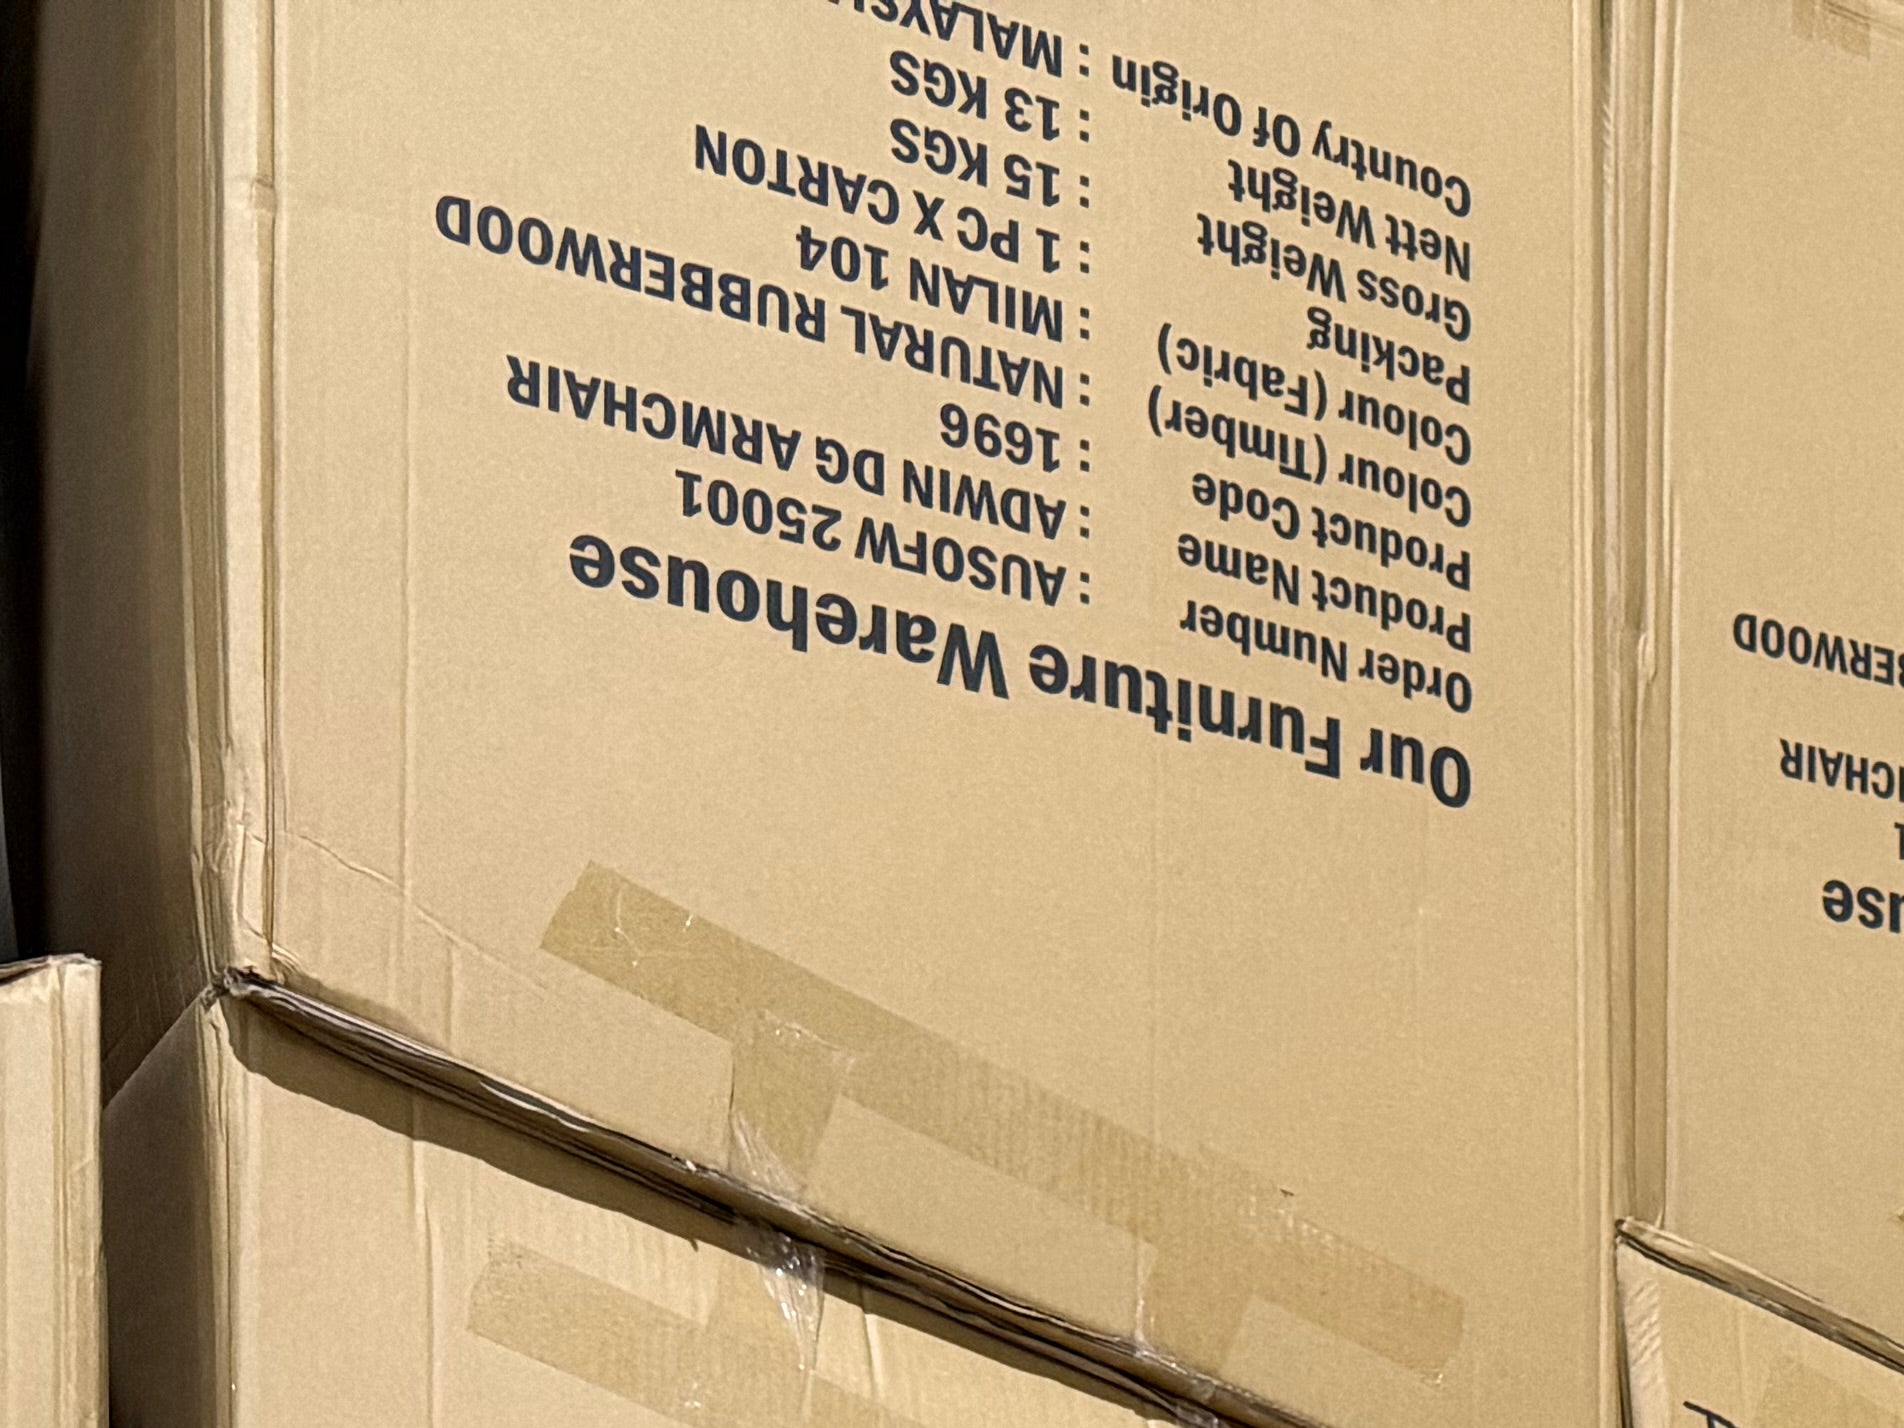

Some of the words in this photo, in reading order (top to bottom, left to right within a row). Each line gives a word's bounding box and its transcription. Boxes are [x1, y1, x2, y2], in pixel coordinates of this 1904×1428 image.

[889, 50, 987, 120] KGS
[1003, 86, 1060, 142] 13
[1227, 158, 1377, 250] Weight
[435, 195, 826, 344] RUBBERWOOD
[1384, 213, 1471, 283] Nett
[840, 304, 1063, 410] NATURAL
[506, 354, 802, 472] ARMCHAIR
[1147, 384, 1328, 486] (Timber)
[815, 435, 885, 497] DG
[902, 458, 1067, 541] ADWIN
[1337, 452, 1472, 528] Colour
[674, 468, 842, 552] 25001
[854, 516, 1067, 607] AUSOFW
[1177, 533, 1300, 607] Name
[569, 534, 1010, 700] Warehouse
[1179, 599, 1348, 683] Number
[1311, 569, 1471, 654] Product
[1028, 643, 1341, 780] Furniture
[1357, 647, 1473, 714] Order
[1359, 727, 1471, 809] Our
